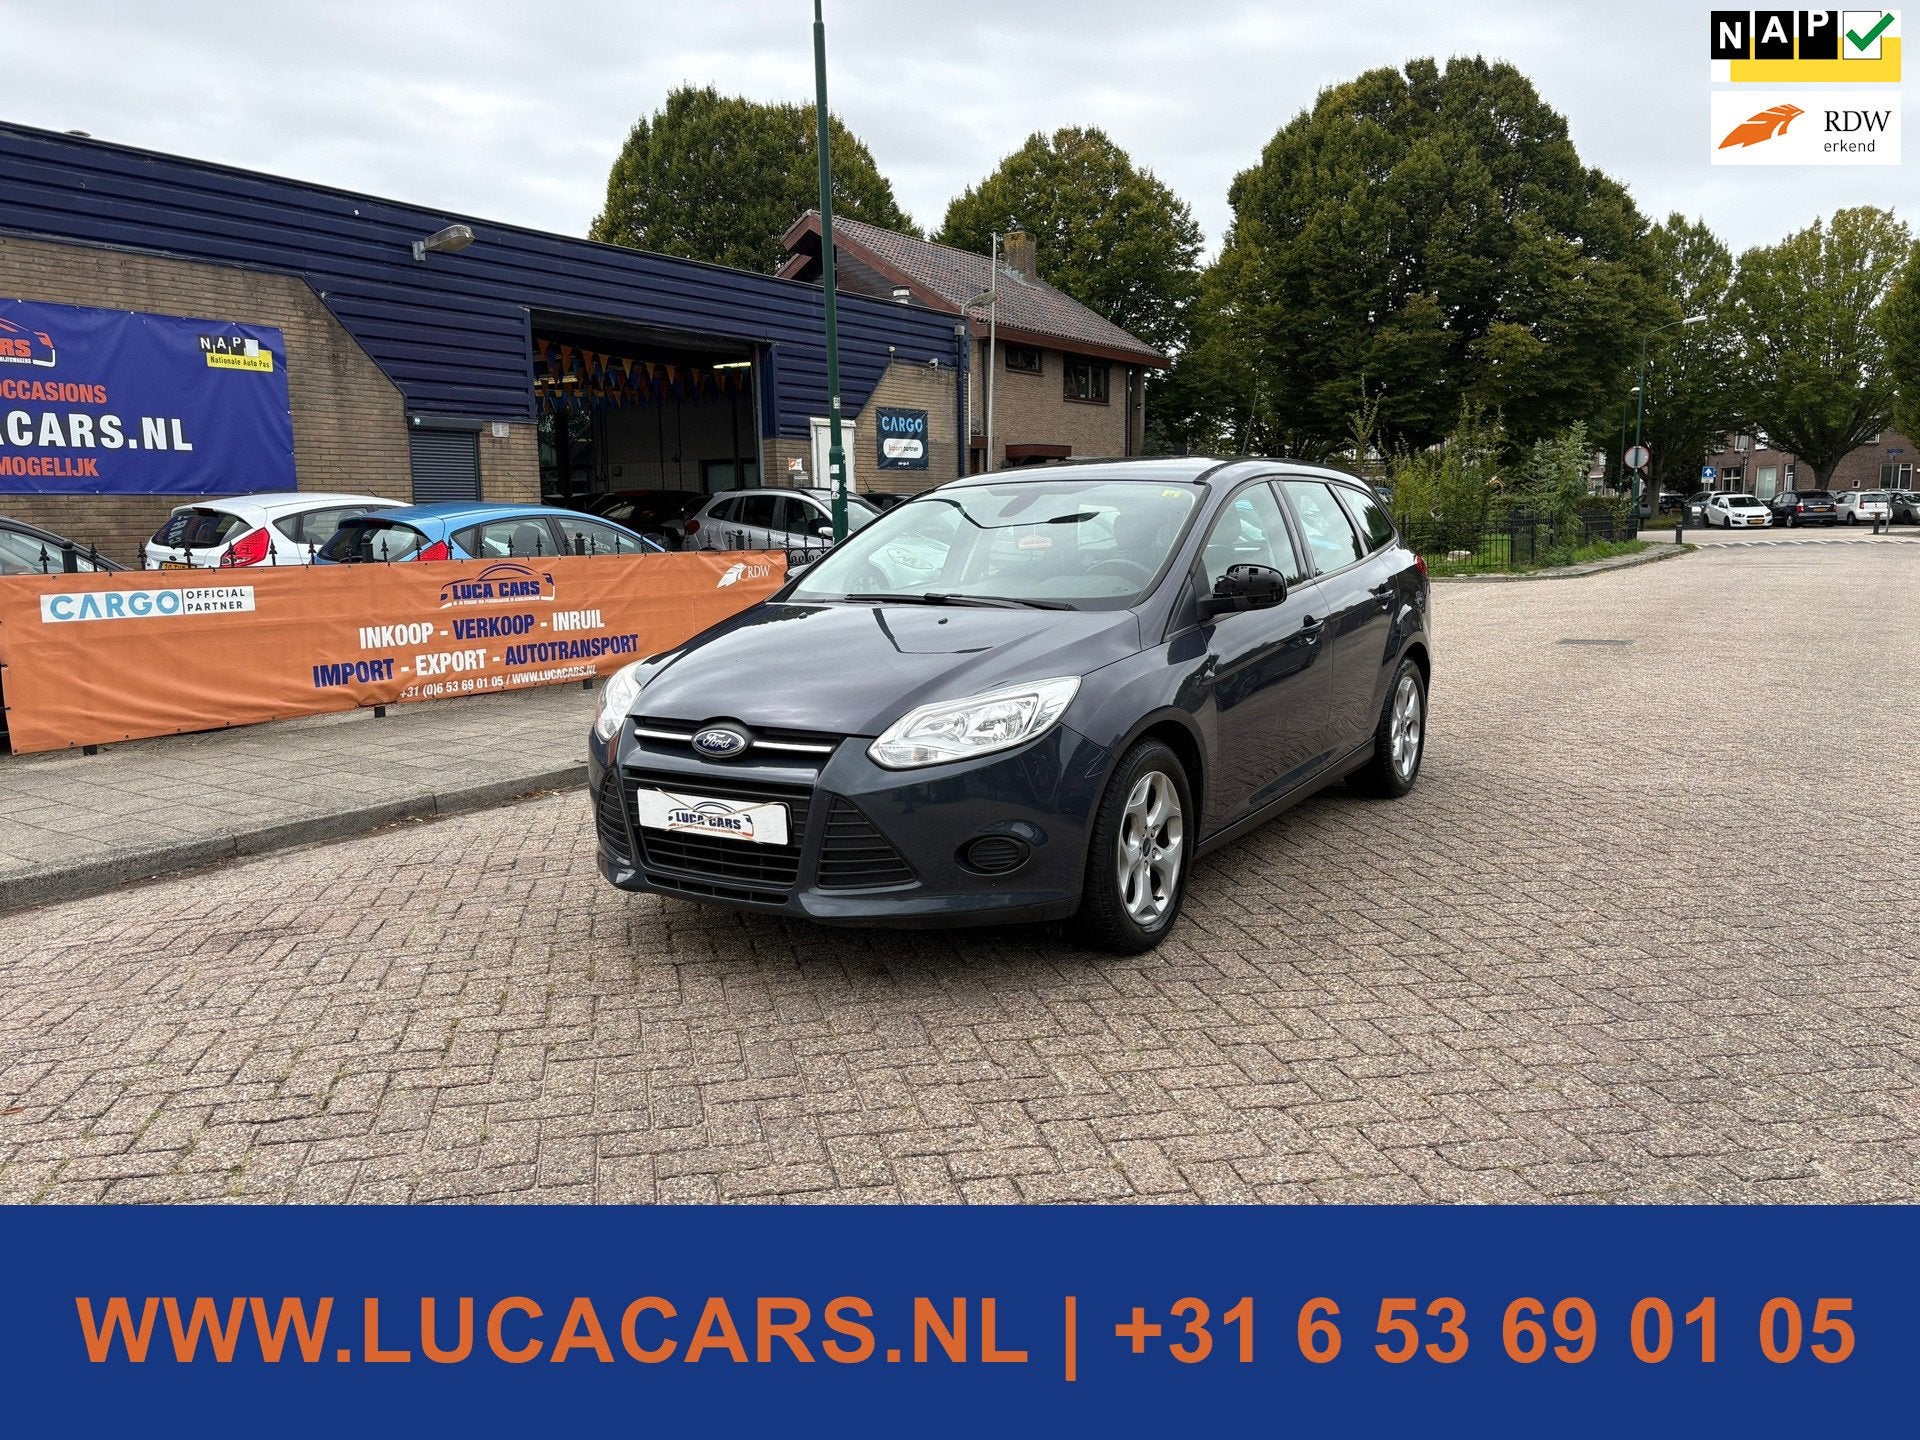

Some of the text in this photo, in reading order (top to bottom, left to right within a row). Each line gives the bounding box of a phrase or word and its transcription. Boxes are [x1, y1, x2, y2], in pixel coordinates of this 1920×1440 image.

[200, 336, 241, 350] NAP
[210, 356, 270, 369] Nationale Auto Pas
[0, 379, 107, 404] CCASIONS
[0, 410, 193, 451] CARS.NL
[881, 416, 923, 433] CARGO
[747, 564, 771, 578] RDW
[186, 588, 246, 600] OFFICIAL
[452, 581, 541, 600] LUCA CARS
[50, 590, 180, 620] CARGO
[187, 601, 243, 612] PARTNER
[359, 622, 434, 649] INKOOP
[453, 614, 535, 640] VERKOOP
[553, 609, 605, 632] INRUIL
[313, 658, 394, 688] IMPORT
[415, 649, 487, 677] EXPORT
[505, 633, 639, 666] AUTOTRANSPORT
[400, 685, 419, 699] +31
[423, 682, 443, 698] (0)6
[446, 681, 459, 693] 53
[461, 679, 474, 691] 69
[476, 677, 488, 689] 01
[491, 676, 504, 688] 05
[512, 664, 597, 684] WWW.LUCACARS.NL
[703, 733, 731, 749] Ford
[708, 816, 742, 830] CARS
